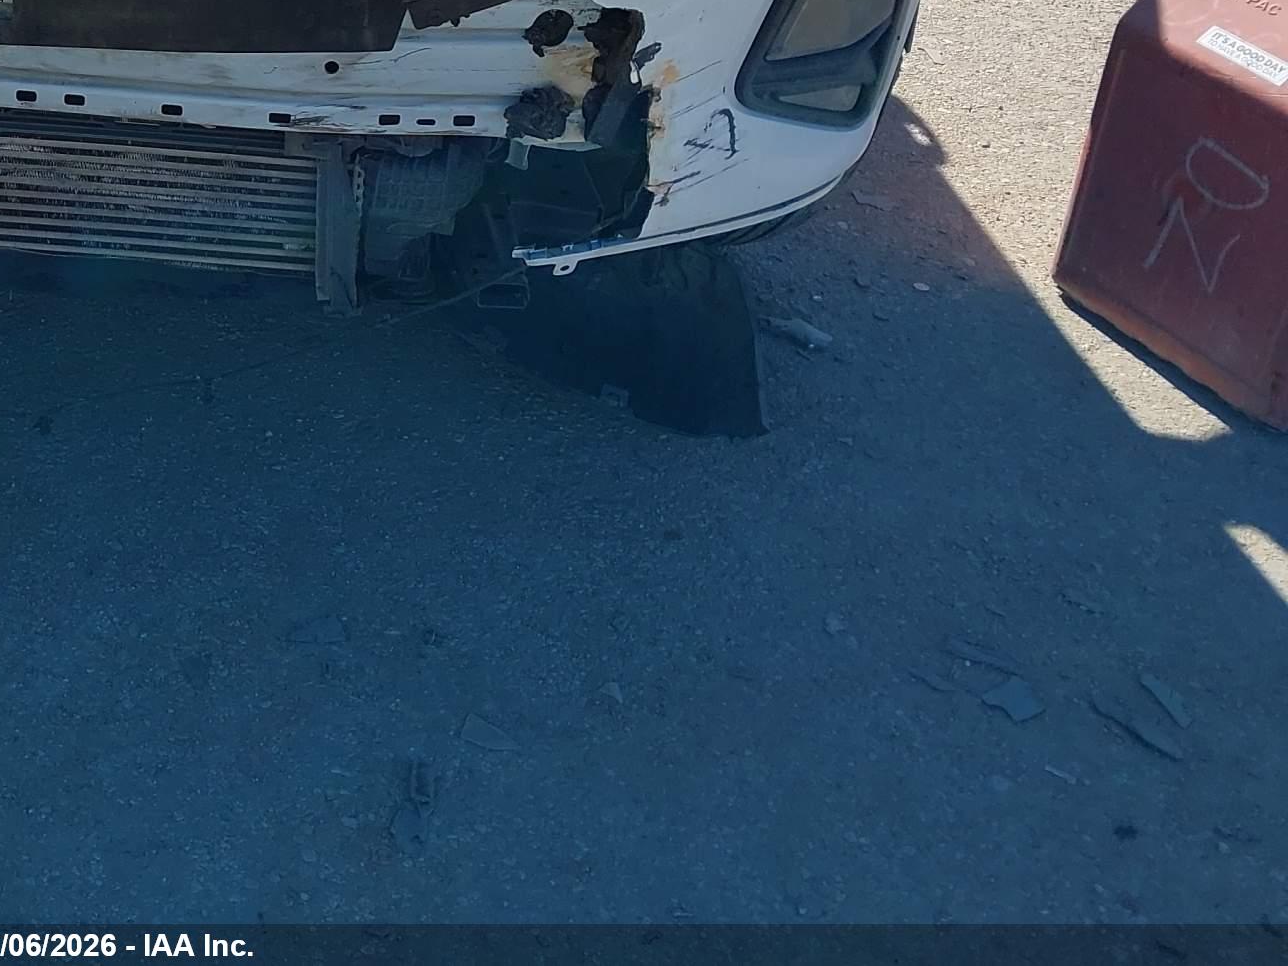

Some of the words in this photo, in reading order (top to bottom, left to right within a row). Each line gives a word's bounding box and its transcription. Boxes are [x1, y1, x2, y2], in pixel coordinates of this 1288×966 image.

[1212, 32, 1231, 44] IT'S
[1228, 41, 1237, 49] A
[1237, 44, 1265, 63] GOOD
[1263, 59, 1286, 73] DAY
